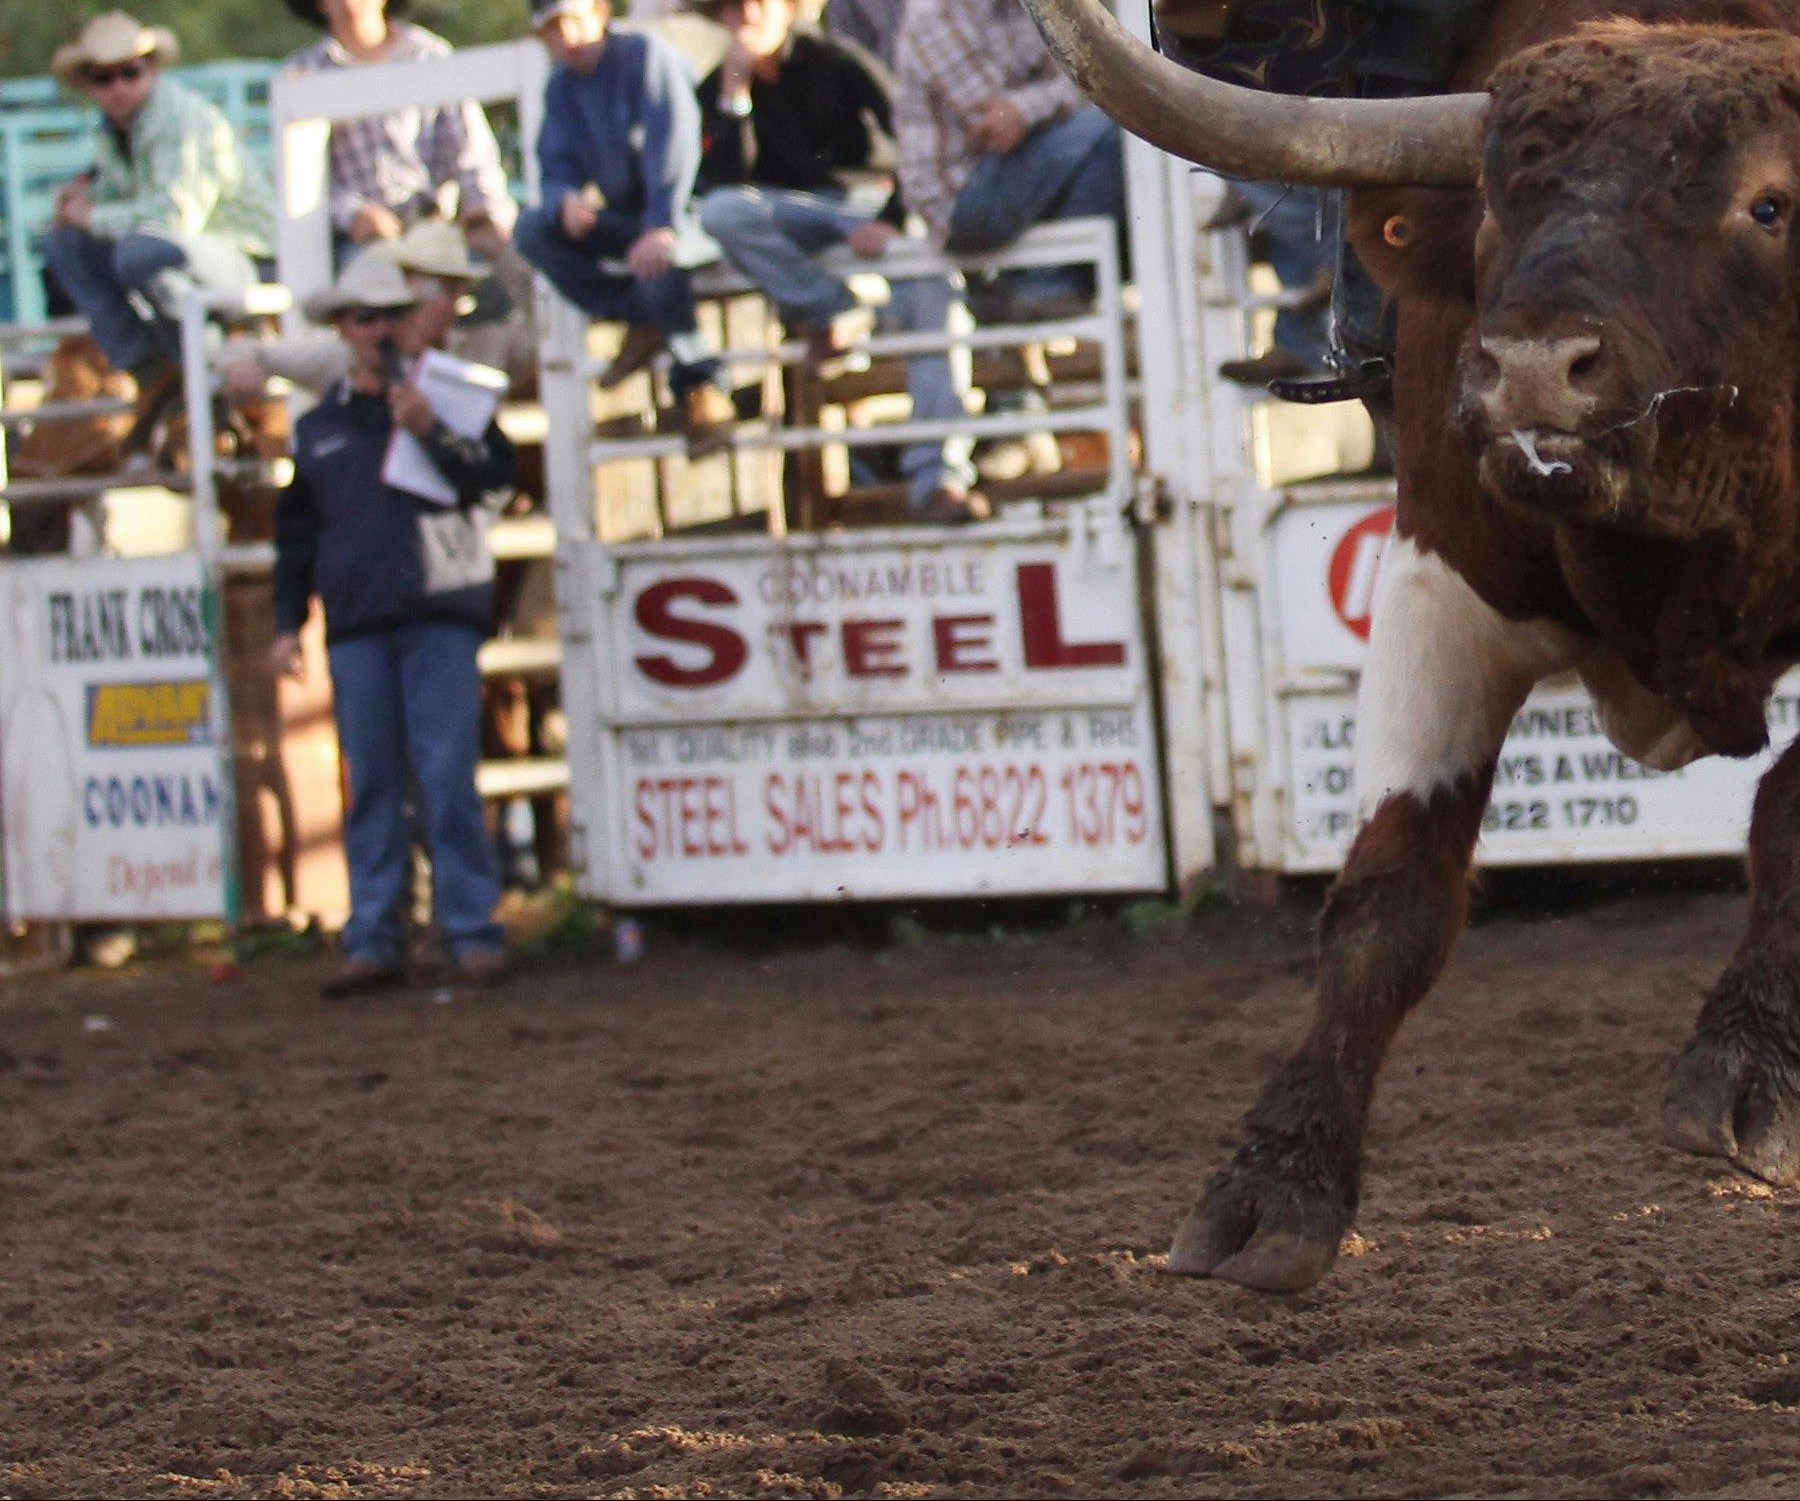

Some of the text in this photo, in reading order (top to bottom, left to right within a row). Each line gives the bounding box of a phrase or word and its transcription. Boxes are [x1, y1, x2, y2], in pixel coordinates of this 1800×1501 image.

[759, 561, 985, 603] COONAMBLE
[49, 590, 131, 663] FRANK
[634, 560, 1128, 689] STEEL
[675, 728, 776, 764] QUALITY
[1553, 753, 1574, 784] A
[636, 774, 749, 861] STEEL
[765, 767, 885, 857] SALES
[1060, 759, 1148, 847] 1379
[1561, 794, 1640, 828] 1710
